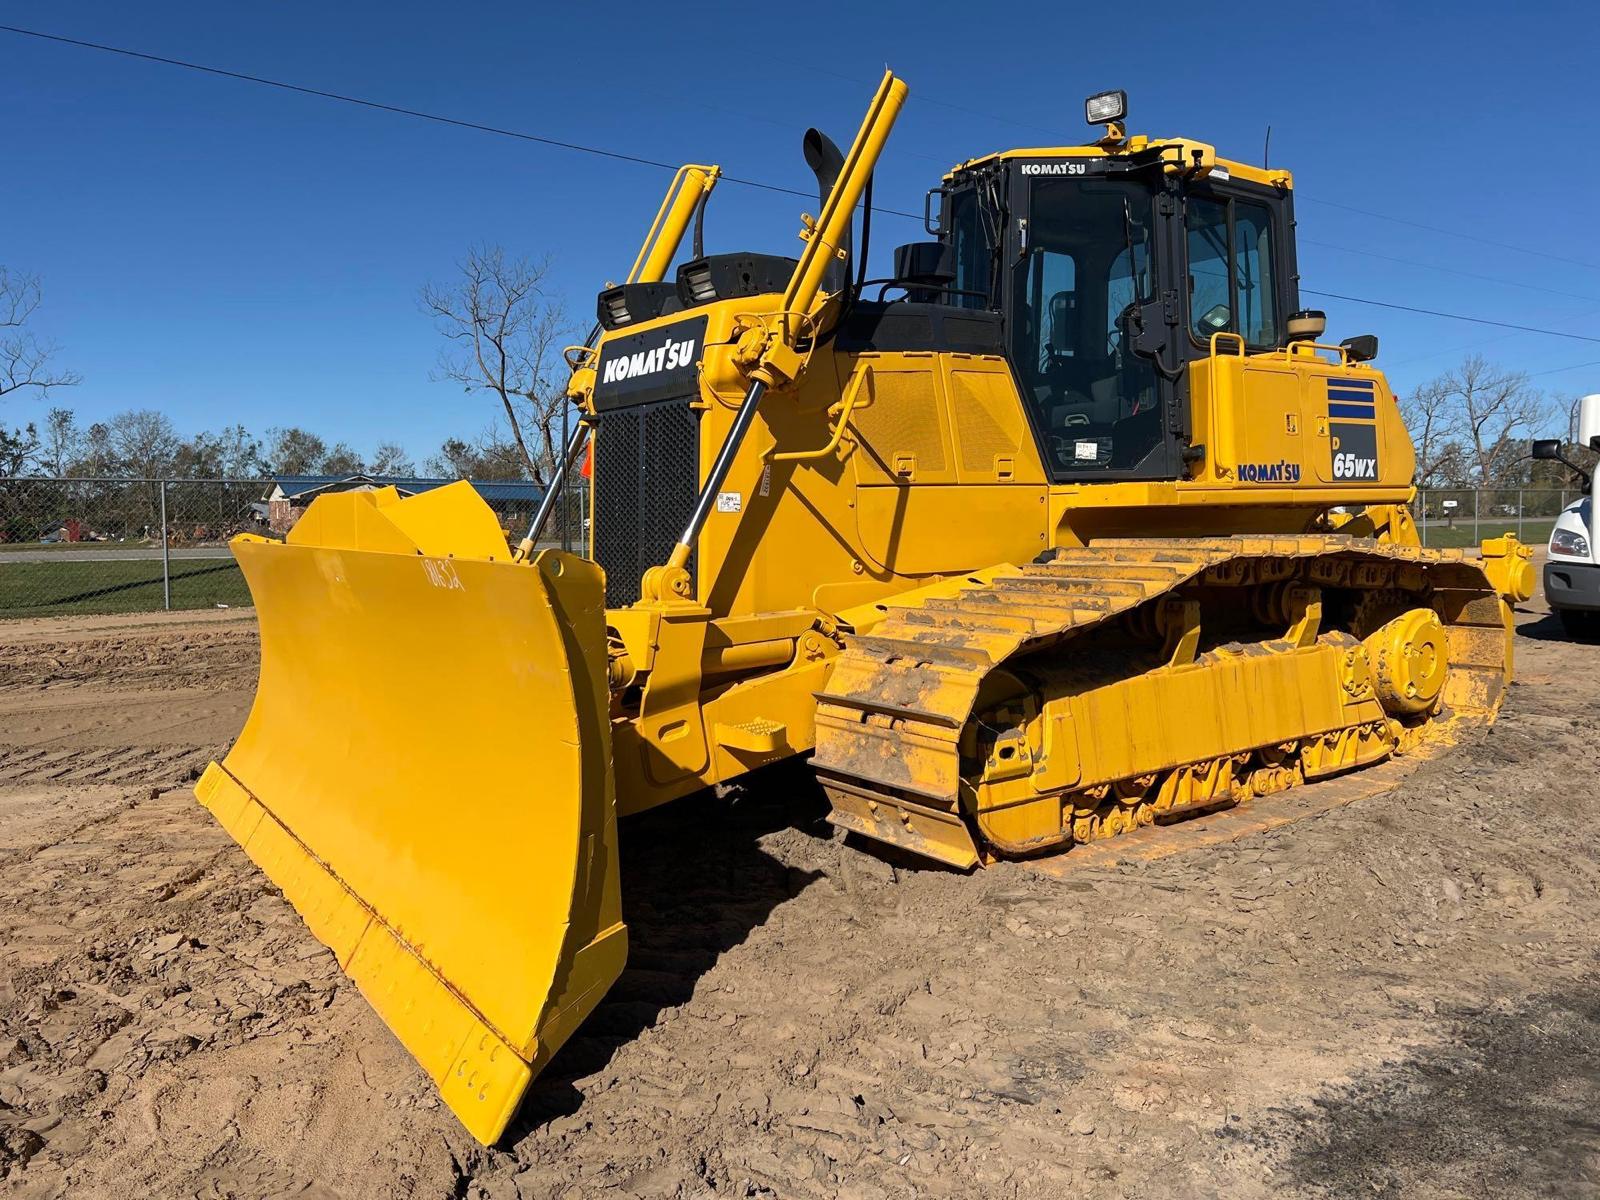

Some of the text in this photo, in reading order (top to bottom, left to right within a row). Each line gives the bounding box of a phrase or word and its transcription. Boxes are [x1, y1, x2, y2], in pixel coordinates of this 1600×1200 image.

[1021, 162, 1086, 175] KOMATSU
[603, 338, 695, 384] KOMATSU
[1332, 437, 1340, 450] D
[1238, 459, 1300, 481] KOMATSU
